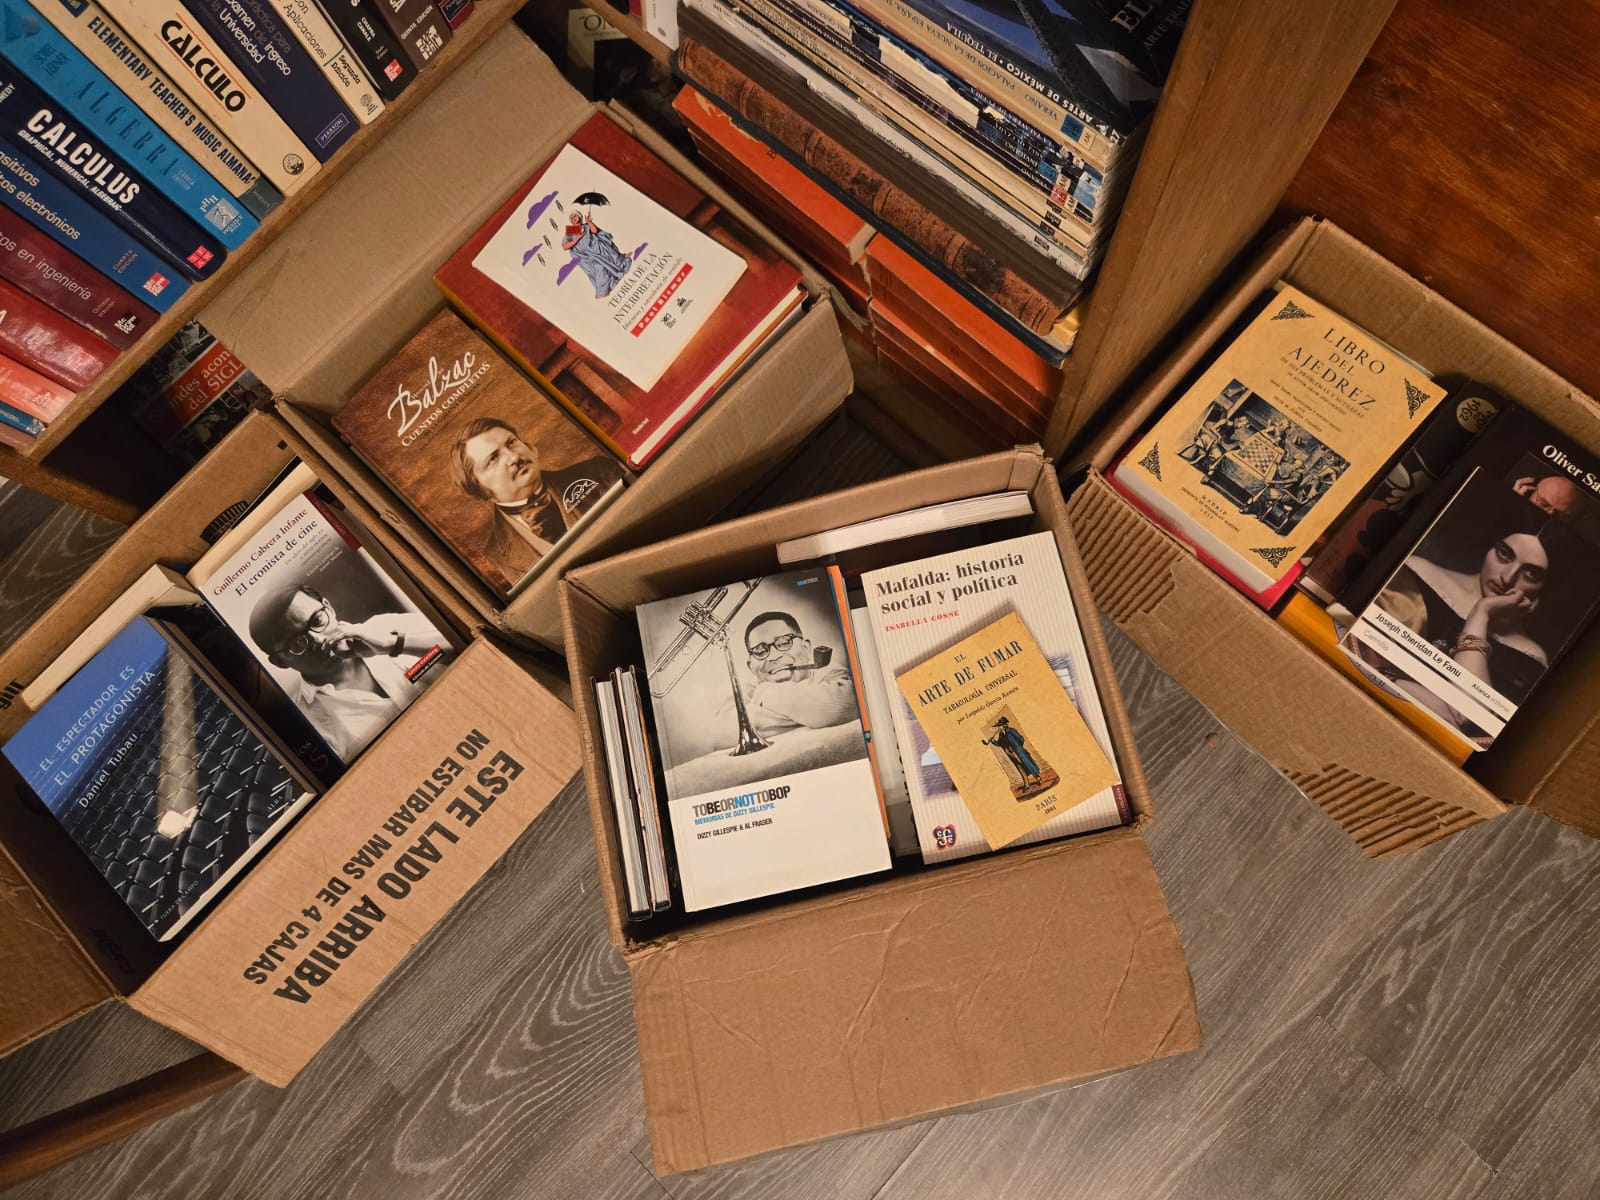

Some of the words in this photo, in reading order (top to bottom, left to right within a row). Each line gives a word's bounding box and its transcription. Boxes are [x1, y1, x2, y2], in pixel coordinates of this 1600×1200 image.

[220, 8, 266, 63] Universidad
[284, 4, 327, 59] Aplicaciones
[926, 24, 952, 46] NUEVA
[946, 21, 985, 54] TEQUILA
[1110, 0, 1153, 33] EL
[161, 20, 246, 112] CALCULO
[264, 41, 291, 76] ingreso
[338, 55, 361, 84] Segunda
[953, 43, 964, 53] LA
[965, 53, 977, 64] DE
[987, 49, 999, 64] EL
[87, 16, 153, 80] ELEMENTARY
[149, 77, 194, 126] TEACHER'S
[192, 123, 221, 154] MUSIC
[331, 63, 350, 87] Edición
[977, 61, 1016, 92] PALACIOS
[1047, 85, 1062, 101] DE
[320, 117, 343, 142] PEARSON
[1025, 93, 1058, 121] VERANO
[1062, 99, 1094, 124] ARTES
[27, 109, 140, 203] CALCULUS
[1002, 140, 1040, 167] INVIERNO
[16, 190, 80, 240] electrónicos
[17, 249, 36, 263] en
[36, 257, 91, 300] ingeniería
[606, 275, 636, 310] TEORÍA
[632, 263, 647, 279] DE
[643, 250, 657, 266] LA
[612, 249, 673, 325] INTERPRETACIÓN
[638, 306, 657, 329] Paul
[1323, 328, 1385, 375] LIBRO
[1328, 352, 1354, 376] DEL
[188, 390, 208, 412] del
[207, 355, 243, 391] SIGL
[387, 352, 476, 437] Balzac
[1288, 347, 1377, 411] AJEDREZ
[401, 405, 444, 447] CUENTOS
[442, 361, 491, 412] COMPLETOS
[1542, 444, 1583, 478] Oliver
[213, 561, 251, 597] Guillermo
[250, 532, 282, 562] Cabrera
[280, 508, 308, 536] Infante
[234, 582, 249, 597] El
[248, 549, 285, 586] cronista
[285, 537, 298, 551] de
[298, 518, 318, 539] cine
[876, 570, 951, 597] Mafalda:
[956, 552, 1025, 579] historia
[880, 592, 932, 615] social
[937, 590, 945, 605] y
[952, 574, 1018, 600] política
[885, 617, 928, 632] ISABELLA
[930, 609, 960, 622] COSSE
[953, 653, 966, 664] EL
[1375, 613, 1401, 634] Joseph
[1401, 630, 1433, 658] Sheridan
[1432, 653, 1443, 664] Le
[1442, 661, 1462, 678] Fanu
[917, 678, 952, 707] ARTE
[954, 666, 975, 687] DE
[977, 639, 1024, 673] FUMAR
[943, 687, 984, 716] TABACOLOGÍA
[985, 669, 1018, 695] UNIVERSAL
[1471, 683, 1491, 700] Alianza
[40, 757, 54, 773] EL
[56, 684, 118, 753] ESPECTADOR
[120, 664, 136, 682] ES
[54, 769, 72, 788] EL
[72, 670, 156, 766] PROTAGONISTA
[455, 728, 490, 760] NO
[78, 767, 109, 808] Daniel
[108, 732, 138, 768] Tubau
[445, 750, 525, 828] ESTE
[382, 756, 464, 837] ESTIBAR
[695, 813, 724, 825] MEMORIAS
[734, 808, 748, 817] DIZZY
[749, 803, 775, 813] GILLESPIE
[1035, 794, 1058, 811] PARÍS
[697, 831, 711, 839] DIZZY
[713, 825, 737, 836] GILLESPIE
[752, 818, 773, 827] FRASER
[342, 833, 393, 880] MAS
[376, 820, 460, 900] LADO
[301, 905, 323, 922] 4
[315, 876, 352, 908] DE
[243, 921, 311, 985] CAJAS
[272, 894, 387, 1004] ARRIBA
